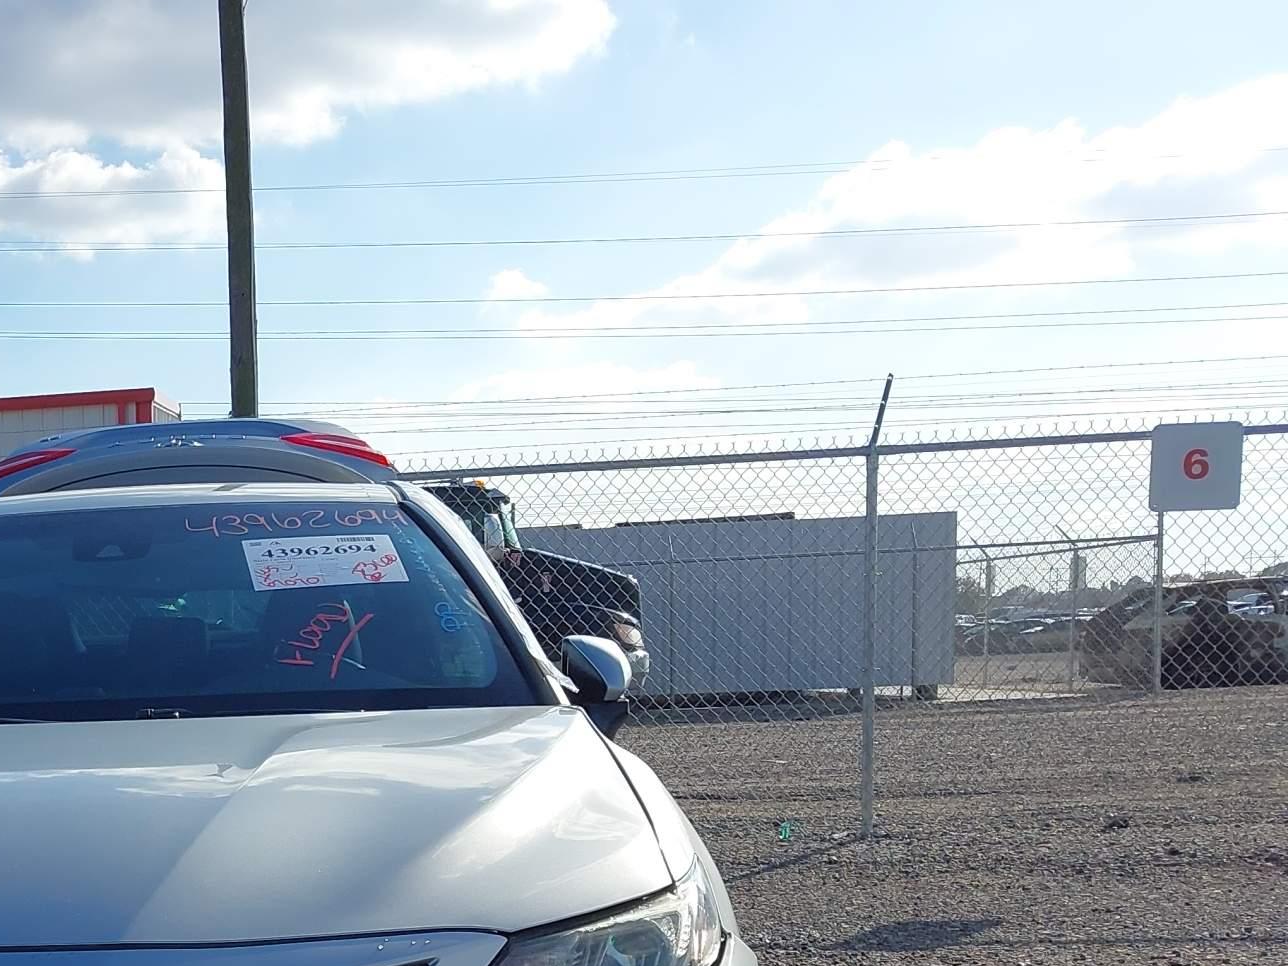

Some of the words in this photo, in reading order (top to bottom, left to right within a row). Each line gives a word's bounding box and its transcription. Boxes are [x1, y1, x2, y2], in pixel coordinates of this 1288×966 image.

[1183, 448, 1209, 480] 6
[185, 509, 409, 537] 43962694
[261, 543, 378, 560] 43962694
